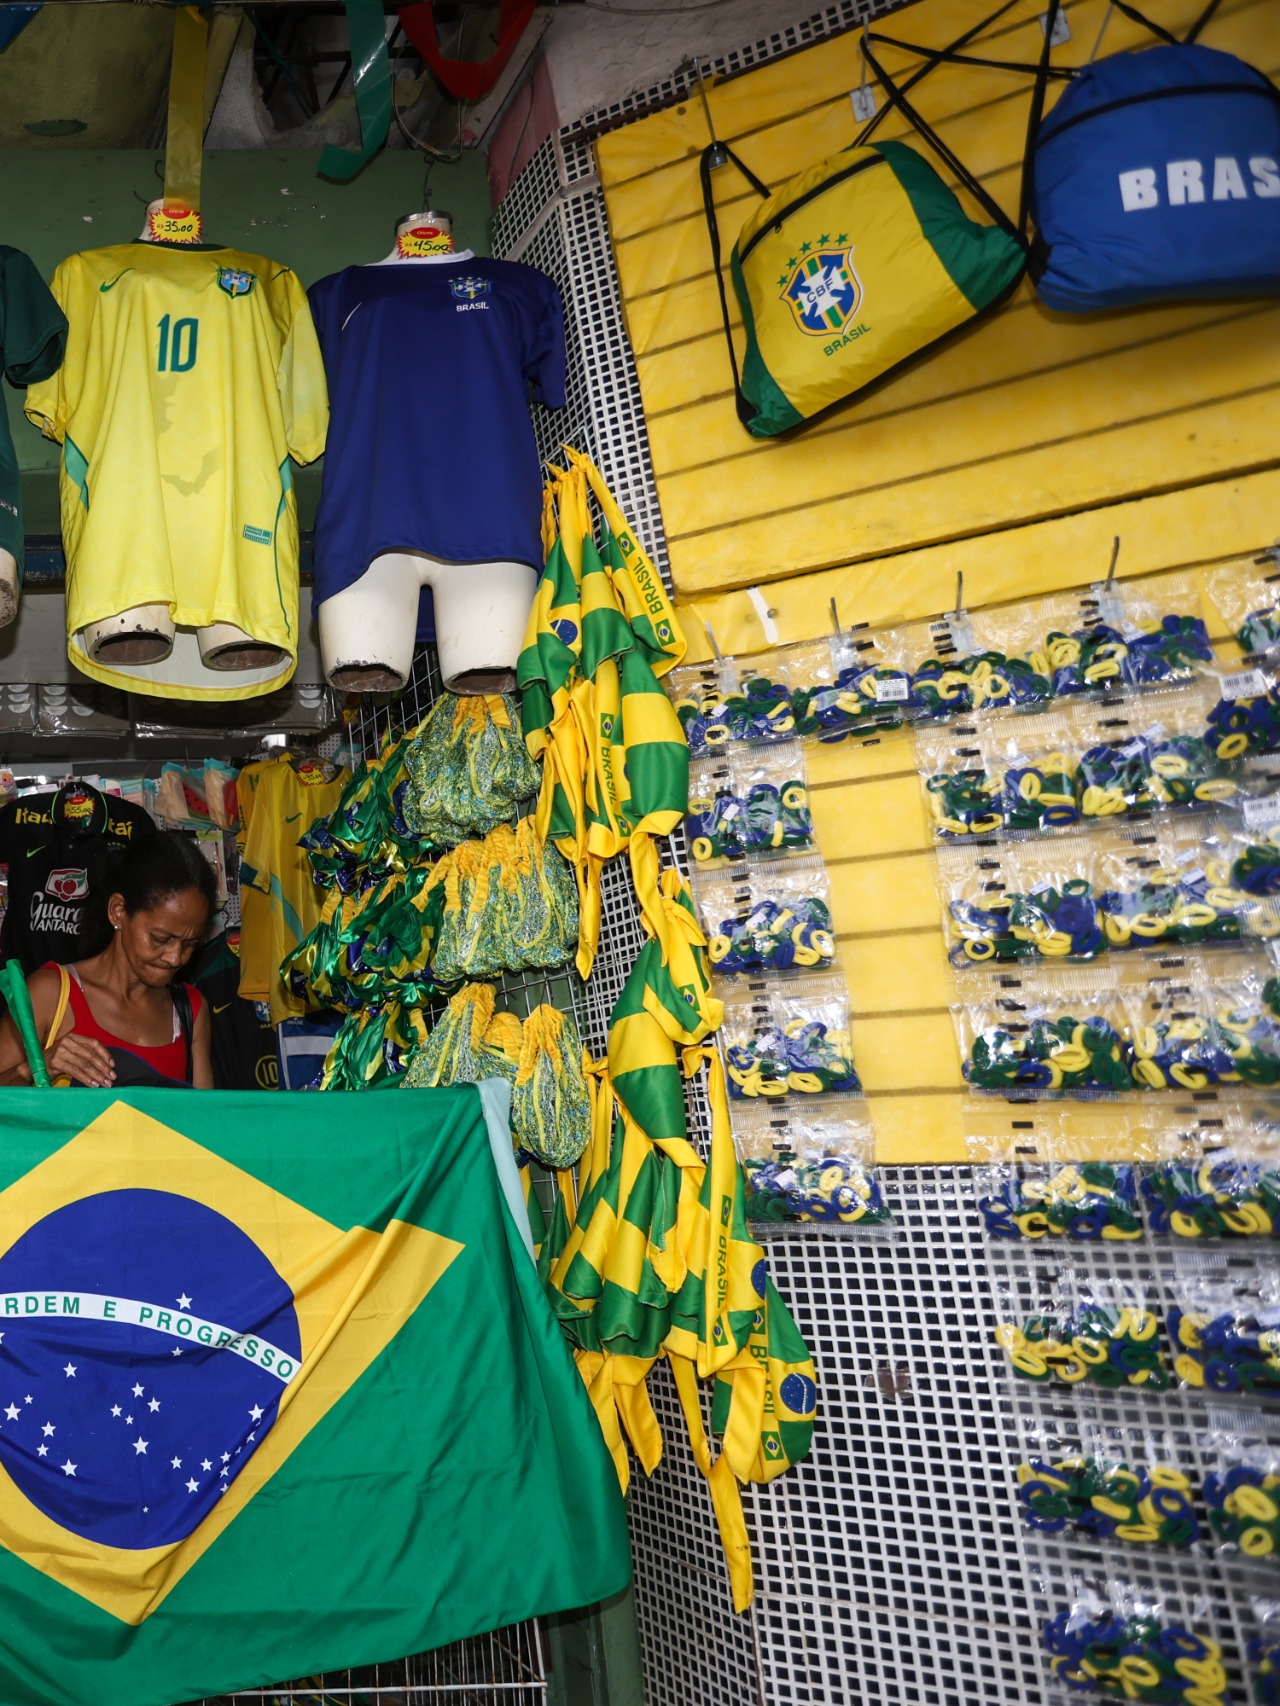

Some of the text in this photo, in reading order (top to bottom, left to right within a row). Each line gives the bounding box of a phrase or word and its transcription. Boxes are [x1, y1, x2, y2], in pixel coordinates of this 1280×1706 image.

[1118, 156, 1280, 213] BRAS
[456, 301, 490, 312] BRASIL
[806, 277, 834, 304] CBF
[156, 313, 199, 372] 10
[823, 323, 871, 357] BRASIL
[633, 556, 664, 615] BRASIL
[601, 746, 617, 805] BRASIL
[36, 918, 81, 936] ANTARC
[717, 1234, 729, 1308] BRASIL
[103, 1300, 118, 1318] E
[139, 1306, 295, 1379] PROGRESSO
